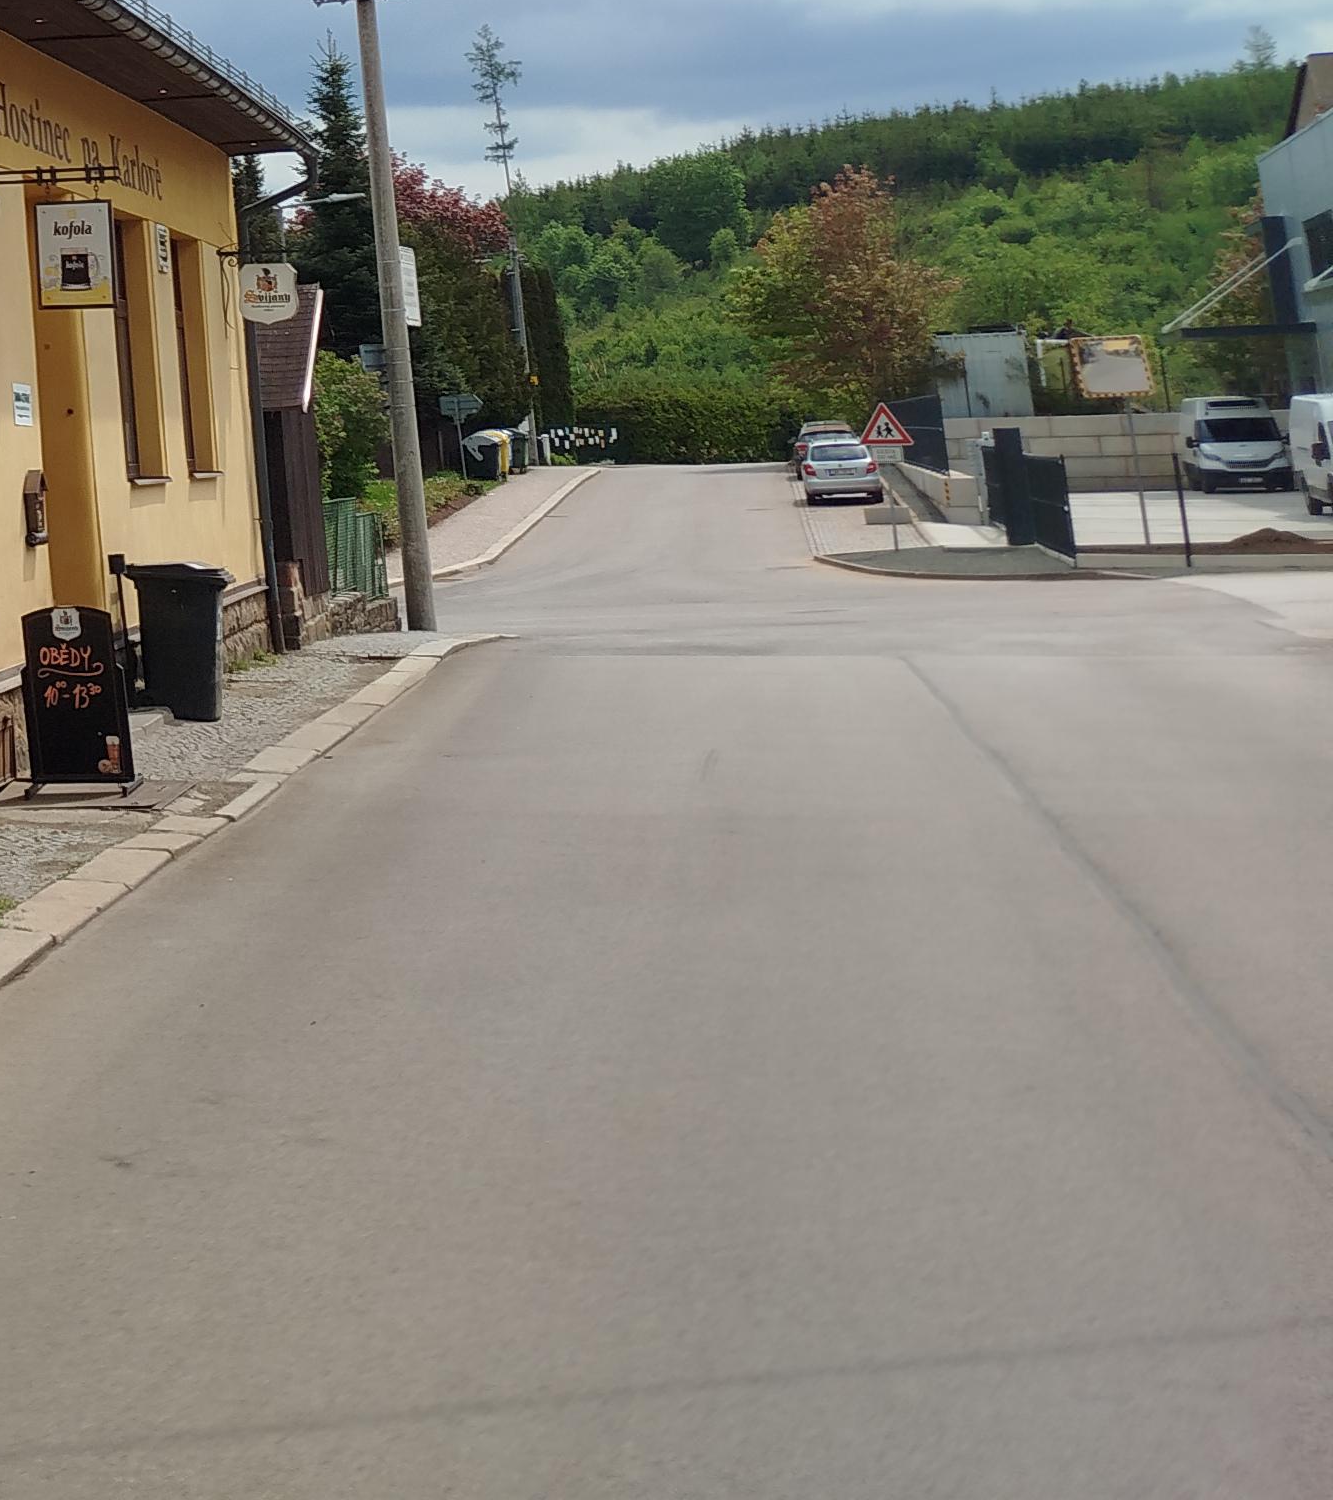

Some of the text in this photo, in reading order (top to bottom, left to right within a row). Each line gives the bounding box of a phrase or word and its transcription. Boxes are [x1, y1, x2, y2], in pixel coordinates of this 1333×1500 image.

[81, 137, 100, 174] na
[53, 220, 93, 239] kofola
[40, 643, 91, 671] OBĚDY
